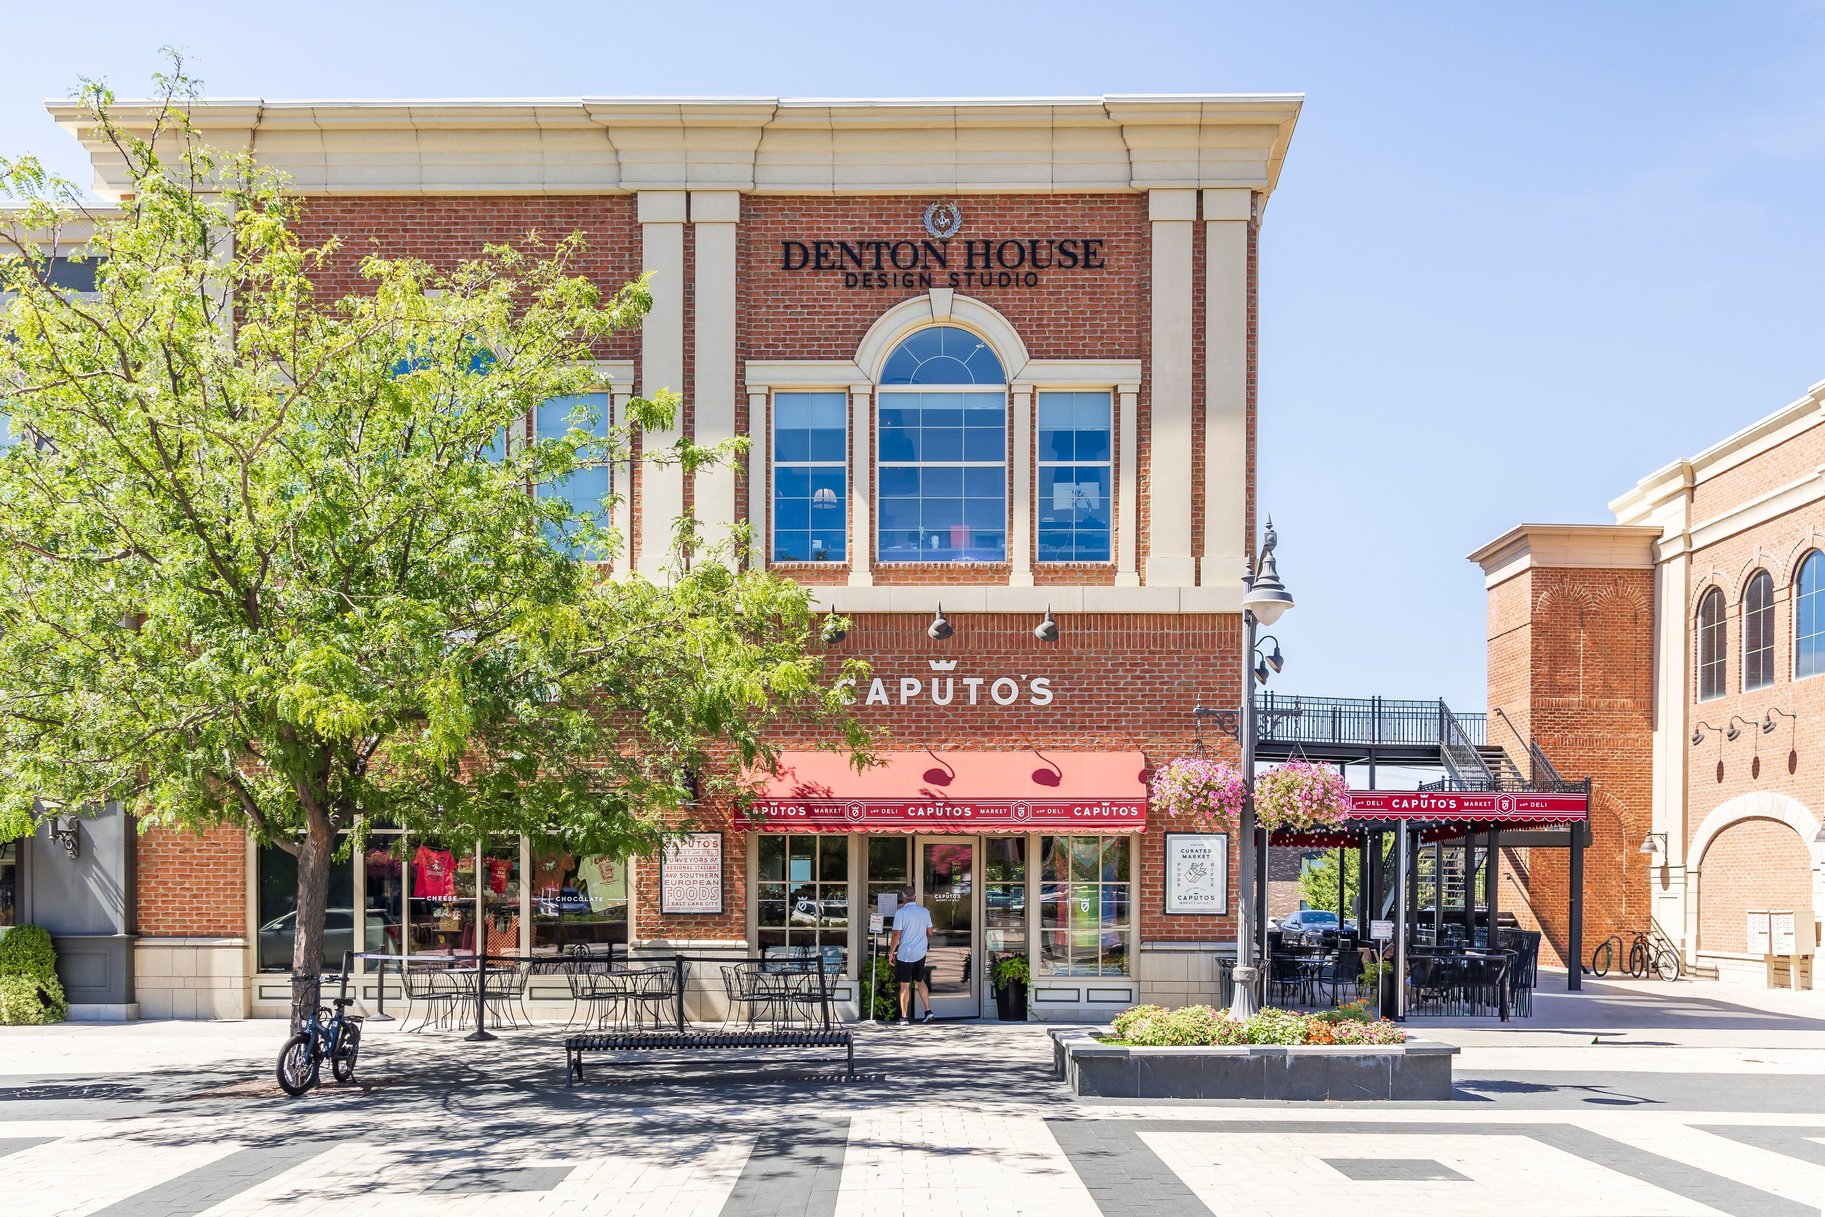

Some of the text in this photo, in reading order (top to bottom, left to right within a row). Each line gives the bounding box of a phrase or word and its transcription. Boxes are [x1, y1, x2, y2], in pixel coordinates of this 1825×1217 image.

[781, 239, 1105, 270] DENTON HOUSE
[845, 272, 1038, 288] DESIGN STUDIO
[908, 806, 972, 816] CAPUTO'S
[1074, 806, 1138, 816] CAPUTO'S
[1392, 798, 1457, 809] CAPUTO'S
[665, 887, 719, 906] FOODS
